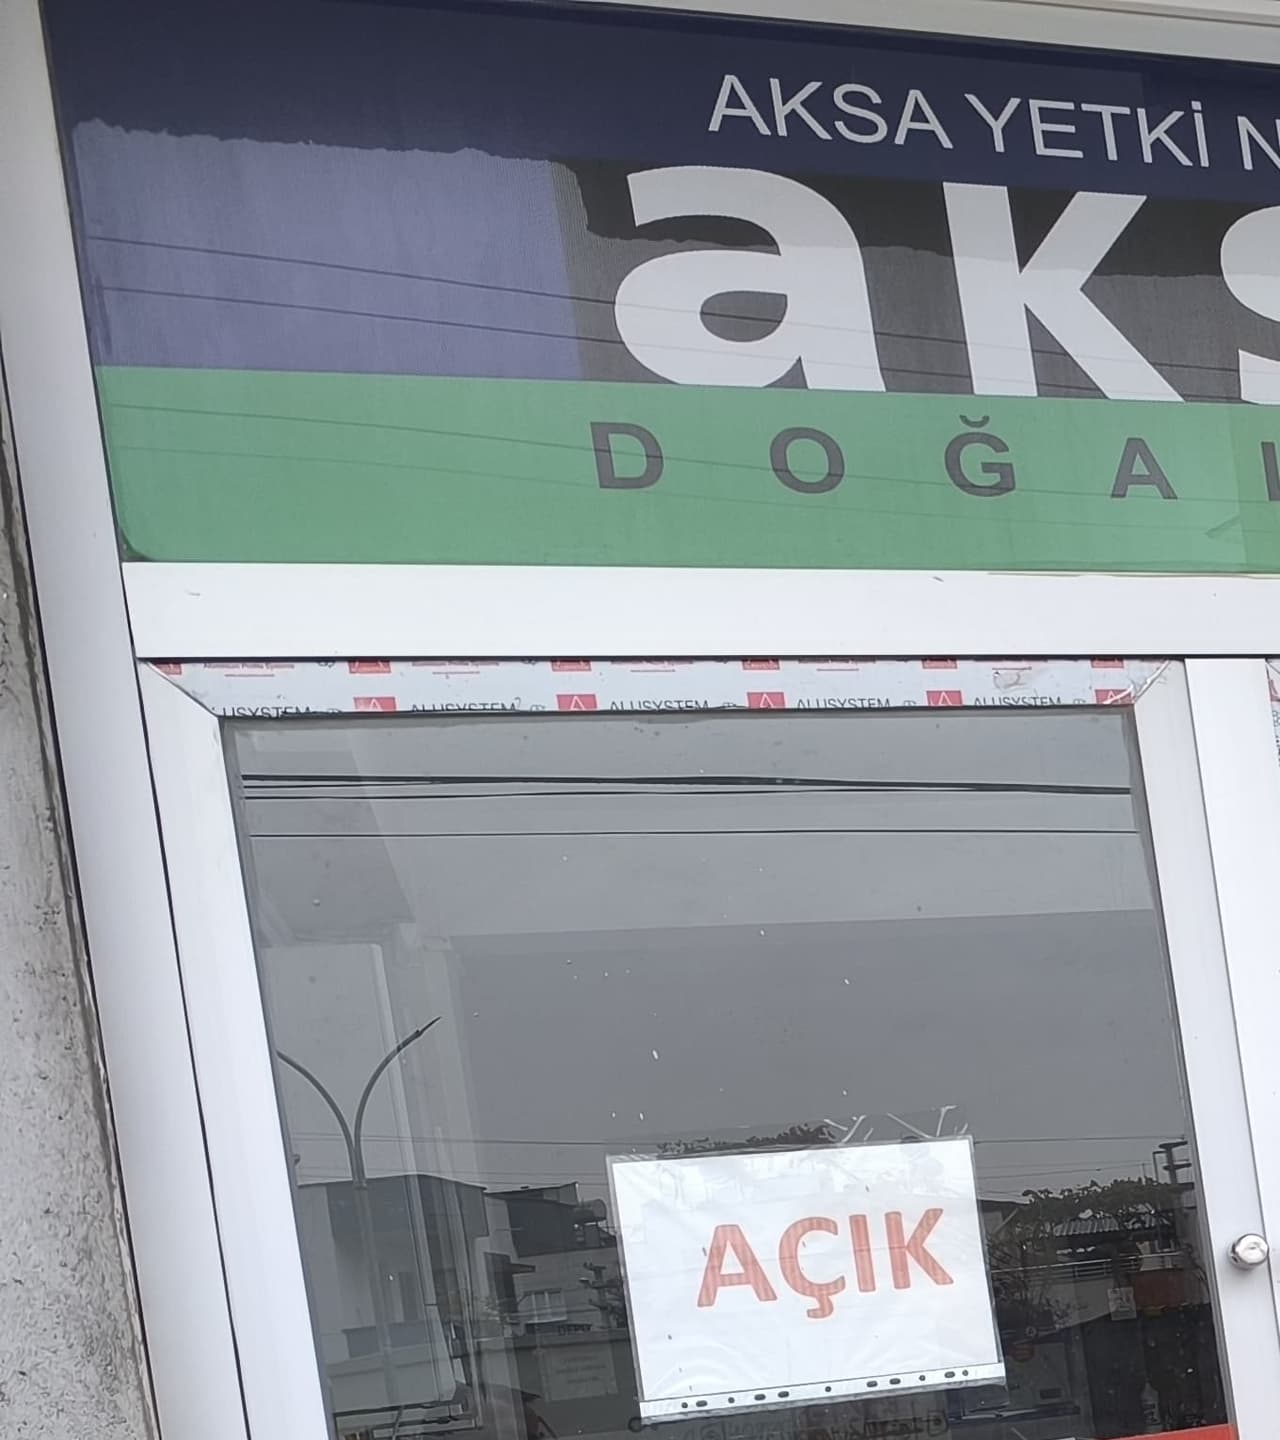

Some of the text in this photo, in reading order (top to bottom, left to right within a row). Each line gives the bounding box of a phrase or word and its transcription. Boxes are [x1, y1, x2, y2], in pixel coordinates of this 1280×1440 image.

[707, 74, 953, 150] AKSA
[965, 92, 1212, 169] YETKİ
[697, 1207, 954, 1319] AÇIK
